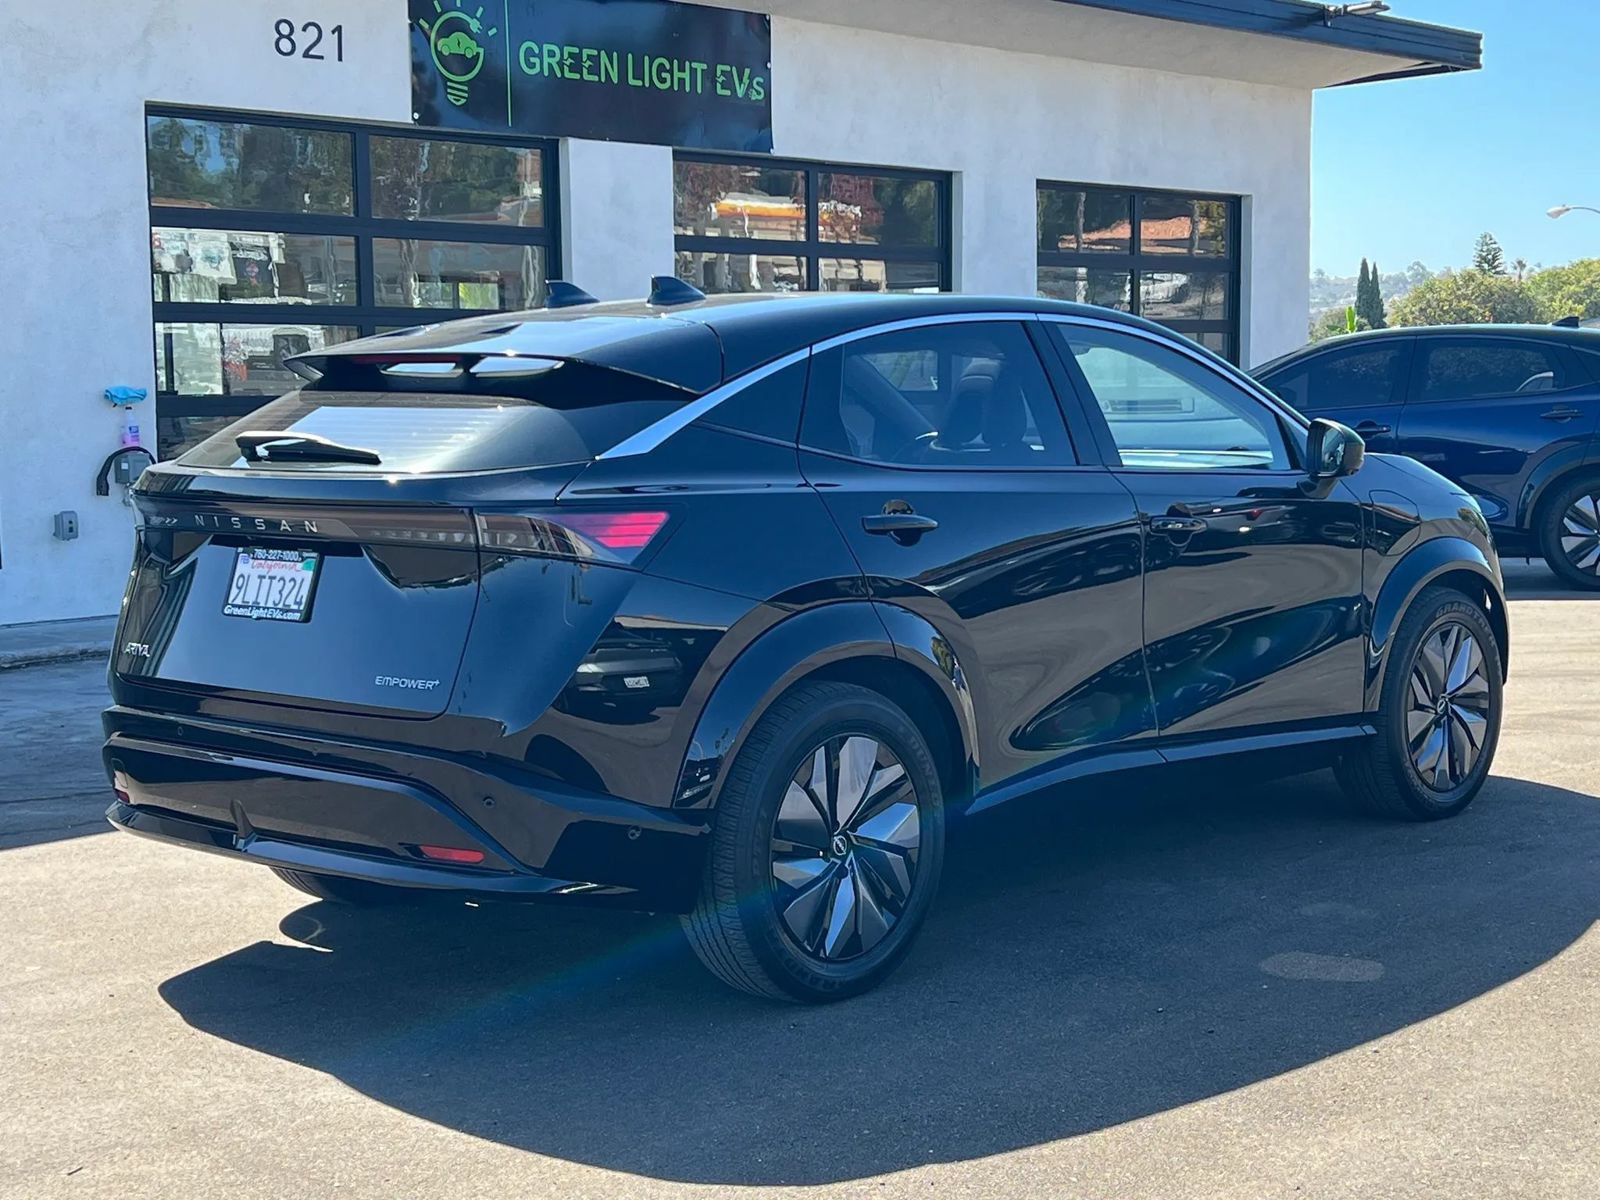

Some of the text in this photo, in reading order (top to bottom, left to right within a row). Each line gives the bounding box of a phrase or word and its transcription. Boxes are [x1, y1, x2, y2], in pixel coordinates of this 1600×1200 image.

[274, 18, 343, 62] 821
[519, 40, 766, 100] GREEN LIGHT EVs
[194, 514, 319, 533] NISSAN
[253, 548, 300, 561] 760-227-1000
[250, 559, 301, 573] California
[223, 605, 301, 620] GreenLightEVs.com
[123, 642, 150, 658] ARIYA
